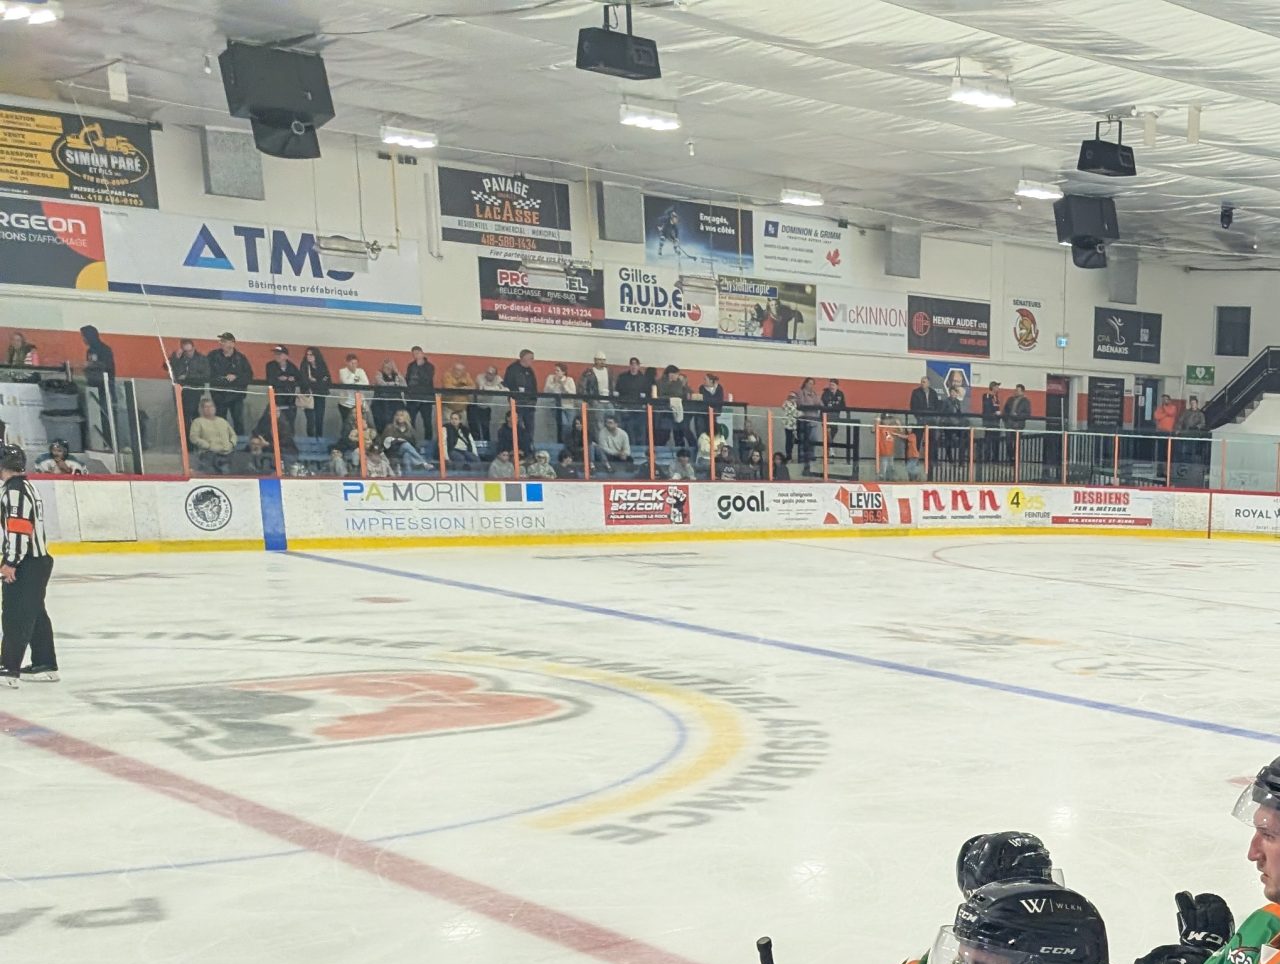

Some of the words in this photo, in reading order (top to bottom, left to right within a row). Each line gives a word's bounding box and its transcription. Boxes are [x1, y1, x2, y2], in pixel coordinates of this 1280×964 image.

[65, 149, 107, 168] SIMON
[110, 153, 142, 173] PARÉ
[482, 176, 531, 199] PAVAGE
[475, 200, 541, 226] LACASSE
[781, 223, 812, 236] DOMINION
[813, 229, 820, 237] &
[819, 229, 842, 241] GRIMM
[183, 223, 356, 282] ATM
[619, 267, 658, 285] Gilles
[248, 279, 297, 293] Bâtiments
[300, 284, 359, 298] préfabriqués
[499, 286, 541, 298] BELLECHASSE
[494, 302, 542, 314] pro-diesel.ca
[548, 308, 562, 316] 418
[619, 305, 687, 319] EXCAVATION
[624, 320, 700, 338] 418-885-4438
[932, 315, 956, 327] HENRY
[956, 318, 978, 328] AUDET
[1096, 344, 1129, 355] ABÉNAKIS
[392, 481, 480, 503] MORIN
[1010, 491, 1022, 508] 4
[1073, 490, 1130, 506] DESBIENS
[610, 502, 664, 512] 247.COM
[717, 490, 770, 520] goal.
[1234, 508, 1272, 520] ROYAL
[345, 516, 467, 532] IMPRESSION
[480, 515, 547, 530] DESIGN
[1019, 898, 1047, 914] W
[1055, 902, 1082, 912] WLKN
[1187, 930, 1229, 945] CM
[1039, 946, 1077, 955] CCM
